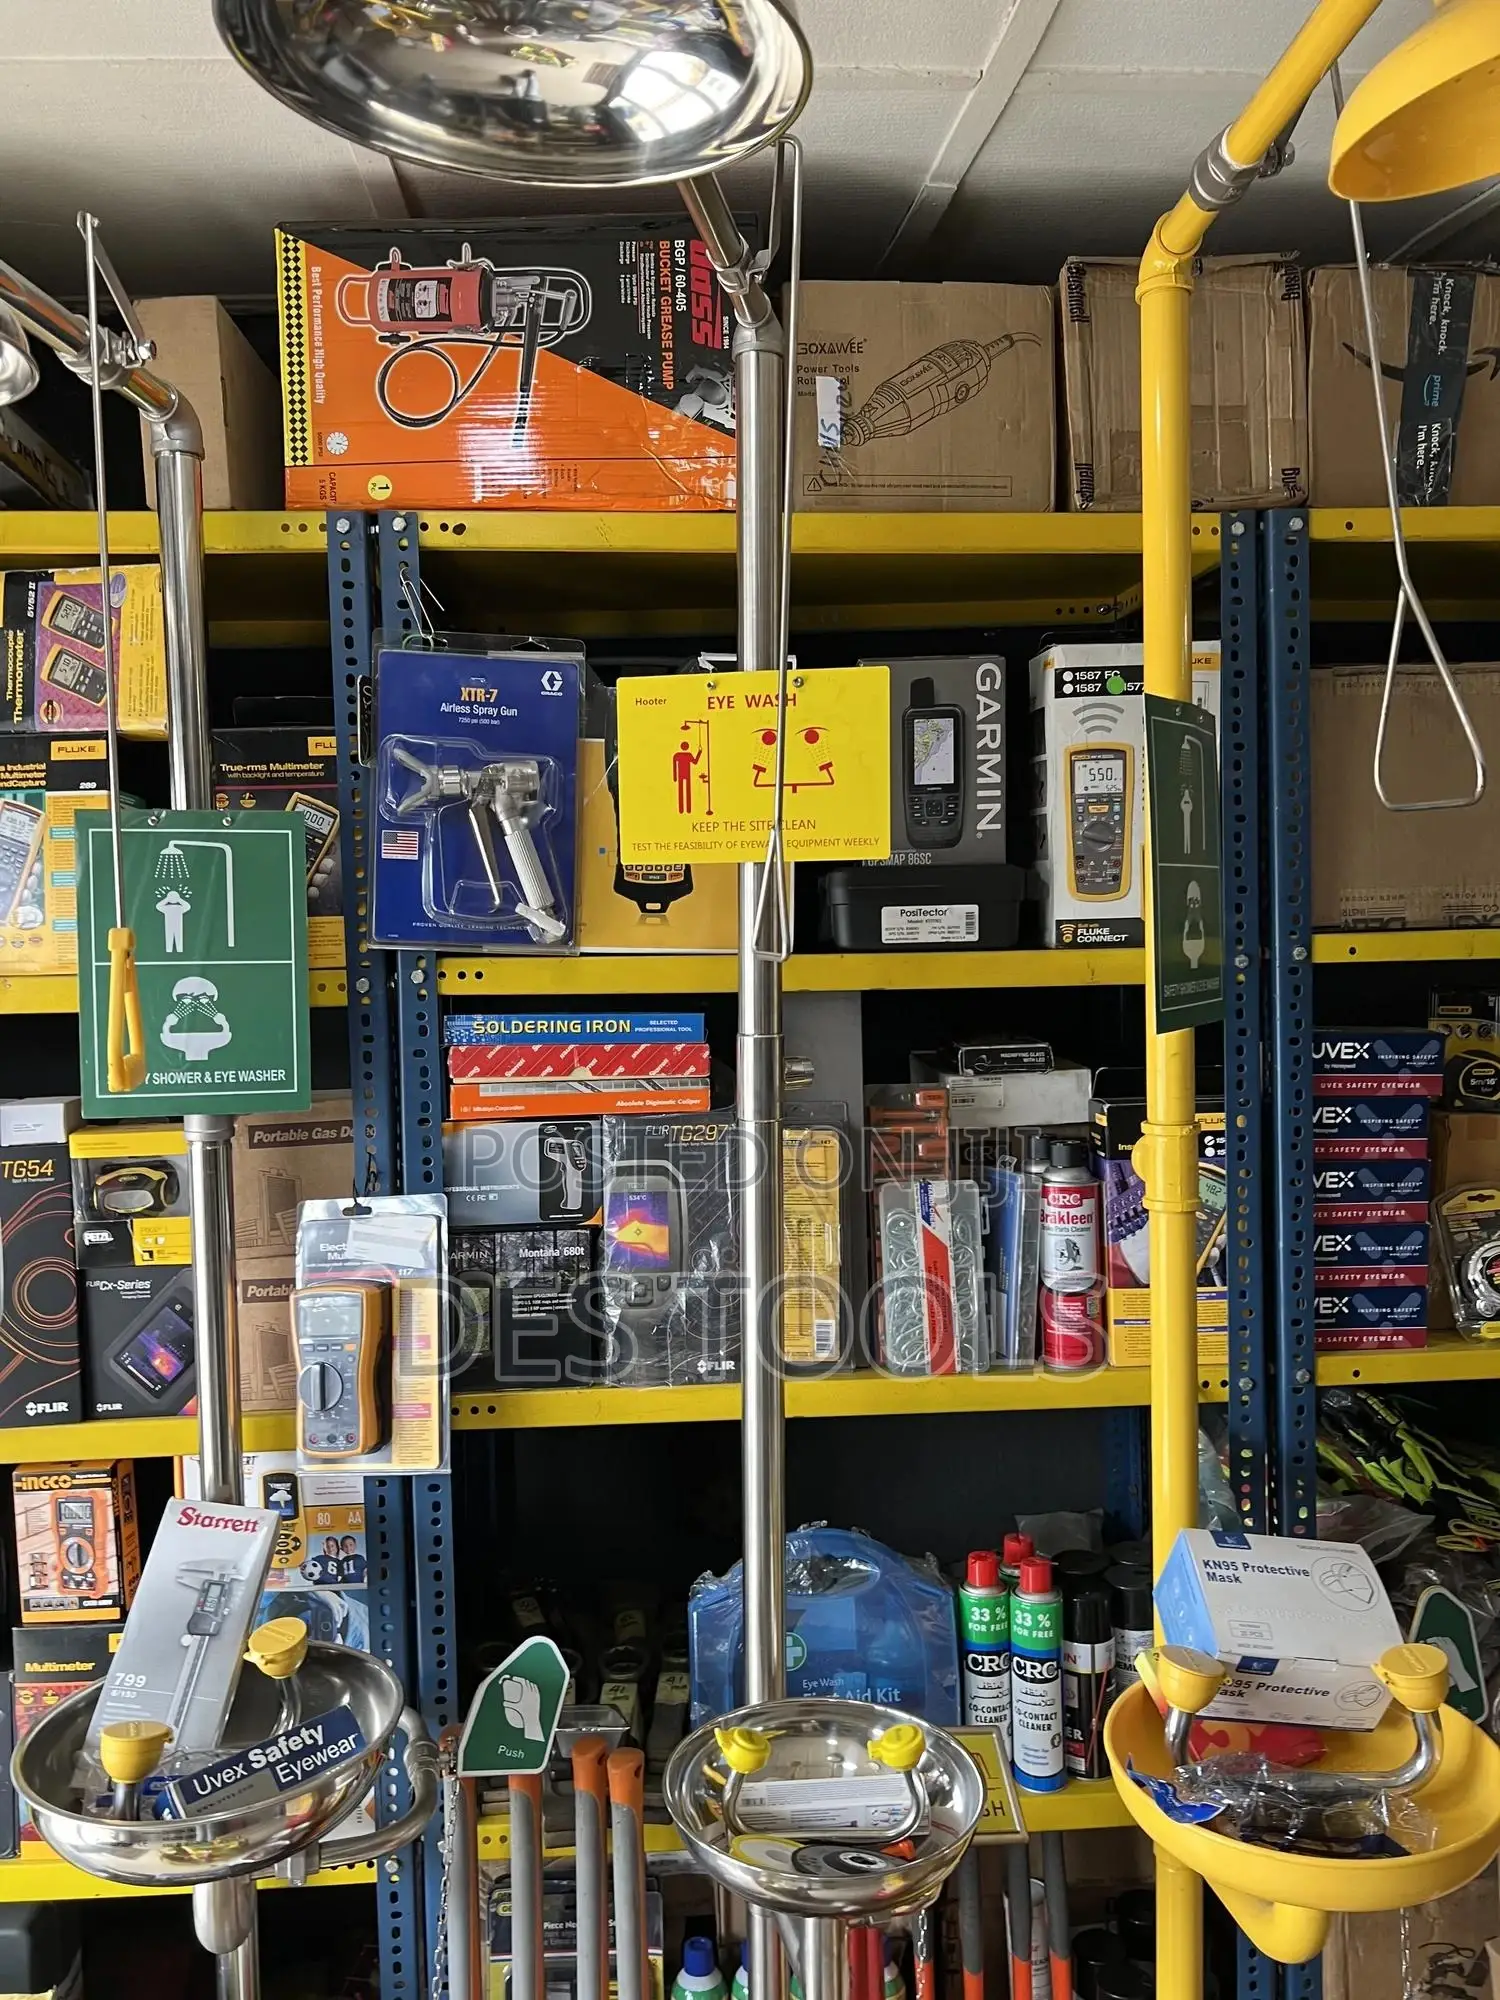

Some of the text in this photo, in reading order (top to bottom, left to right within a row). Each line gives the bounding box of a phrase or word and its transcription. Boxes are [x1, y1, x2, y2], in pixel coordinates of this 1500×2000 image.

[674, 239, 686, 266] BGP
[675, 274, 687, 312] 60-405
[659, 240, 675, 391] BUCKET GREASE PUMP
[1428, 298, 1440, 326] here.
[1436, 278, 1455, 356] Knock, knock.
[311, 266, 325, 404] Best Performance High Quality
[797, 364, 860, 374] Power Tools
[1428, 374, 1442, 408] prime
[1415, 424, 1427, 470] I'm here.
[1429, 422, 1442, 458] Knock,
[5, 629, 14, 701] Thermocouple
[13, 629, 25, 724] Thermometer
[1074, 671, 1102, 680] 1587
[461, 687, 498, 702] XTR-7
[1074, 684, 1102, 693] 1587
[440, 702, 518, 716] Airless Spray Gun
[636, 698, 666, 706] Hooter
[708, 696, 734, 710] EYE
[57, 745, 96, 754] FLUKE
[974, 662, 1002, 831] GARMIN
[6, 763, 46, 772] Industrial
[220, 762, 324, 772] True-rms Multimeter
[0, 771, 46, 780] Multimeter
[242, 772, 270, 780] backlight
[284, 771, 324, 779] temperature
[692, 822, 720, 832] KEEP
[723, 822, 746, 832] THE
[749, 820, 773, 832] SITE
[632, 837, 880, 852] TEST THE FEASIBILITY OF EYEWA EQUIPMENT WEEKLY
[908, 852, 932, 865] 86SC
[900, 908, 948, 918] PosiTector
[1077, 934, 1128, 942] CONNECT
[1078, 928, 1110, 936] FLUKE
[474, 1020, 631, 1034] SOLDERING IRON
[1312, 1042, 1370, 1060] UVEX
[152, 1072, 202, 1084] SHOWER
[204, 1072, 212, 1082] &
[214, 1071, 236, 1083] EYE
[238, 1070, 286, 1082] WASHER
[254, 1129, 310, 1144] Portable
[312, 1128, 338, 1141] Gas
[645, 1124, 729, 1142] FLIR TG297
[1, 1159, 54, 1178] TG54
[1048, 1194, 1080, 1206] CRC
[450, 1251, 488, 1260] ARMIN
[519, 1246, 584, 1258] Montana 680t
[100, 1280, 151, 1291] Cx-Series
[707, 1360, 736, 1370] FLIR
[37, 1402, 68, 1413] FLIR
[103, 1403, 123, 1411] FLIR
[176, 1506, 260, 1534] Starrett
[1202, 1560, 1310, 1577] KN95 Protective
[1206, 1572, 1242, 1584] Mask
[971, 1606, 1006, 1622] 33 %
[1014, 1610, 1051, 1628] 33 %
[968, 1622, 1008, 1632] FOR FREE
[1014, 1626, 1054, 1638] FOR FREE
[25, 1660, 96, 1674] Multimeter
[1012, 1656, 1058, 1679] CRC
[114, 1672, 146, 1688] 799
[802, 1678, 844, 1690] Eye Wash
[846, 1688, 902, 1702] Aid Kit
[1218, 1688, 1246, 1698] ask
[1256, 1682, 1330, 1697] Protective
[974, 1714, 1008, 1723] CLEANER
[1014, 1706, 1058, 1720] CO-CONTACT
[1018, 1719, 1052, 1732] CLEANER
[275, 1733, 358, 1784] Eyewear
[498, 1744, 525, 1760] Push
[193, 1723, 324, 1796] Uvex Safety
